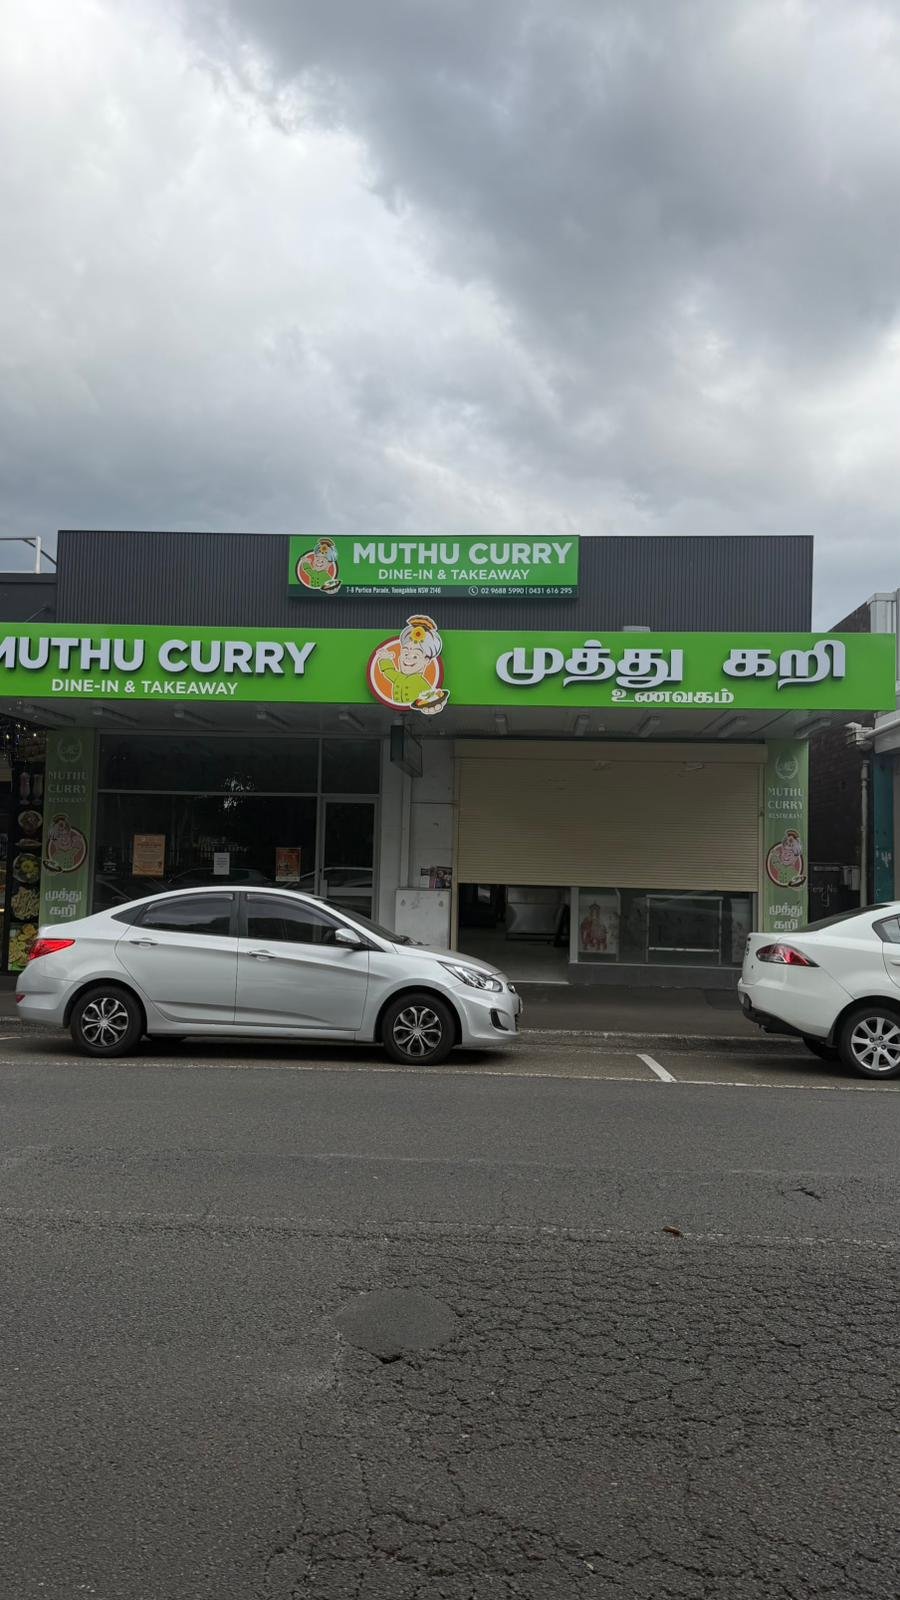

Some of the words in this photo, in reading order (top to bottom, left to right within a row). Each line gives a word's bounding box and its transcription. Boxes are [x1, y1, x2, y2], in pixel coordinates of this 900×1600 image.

[353, 543, 460, 565] MUTHU
[468, 543, 573, 565] CURRY
[378, 569, 433, 580] DINE-IN
[437, 569, 448, 581] &
[451, 569, 530, 581] TAKEAWAY
[417, 586, 429, 594] NSW
[429, 586, 442, 594] 2146
[158, 639, 317, 674] CURRY
[495, 639, 684, 689] முத்து
[722, 639, 846, 690] கறி
[51, 678, 119, 692] DINE-IN
[124, 680, 136, 693] &
[141, 681, 238, 695] TAKEAWAY
[611, 687, 735, 704] உணவகம்
[767, 800, 803, 810] CURRY
[45, 887, 82, 903] முத்து
[49, 903, 77, 918] கறி
[769, 902, 803, 918] முத்து
[773, 918, 799, 932] கறி
